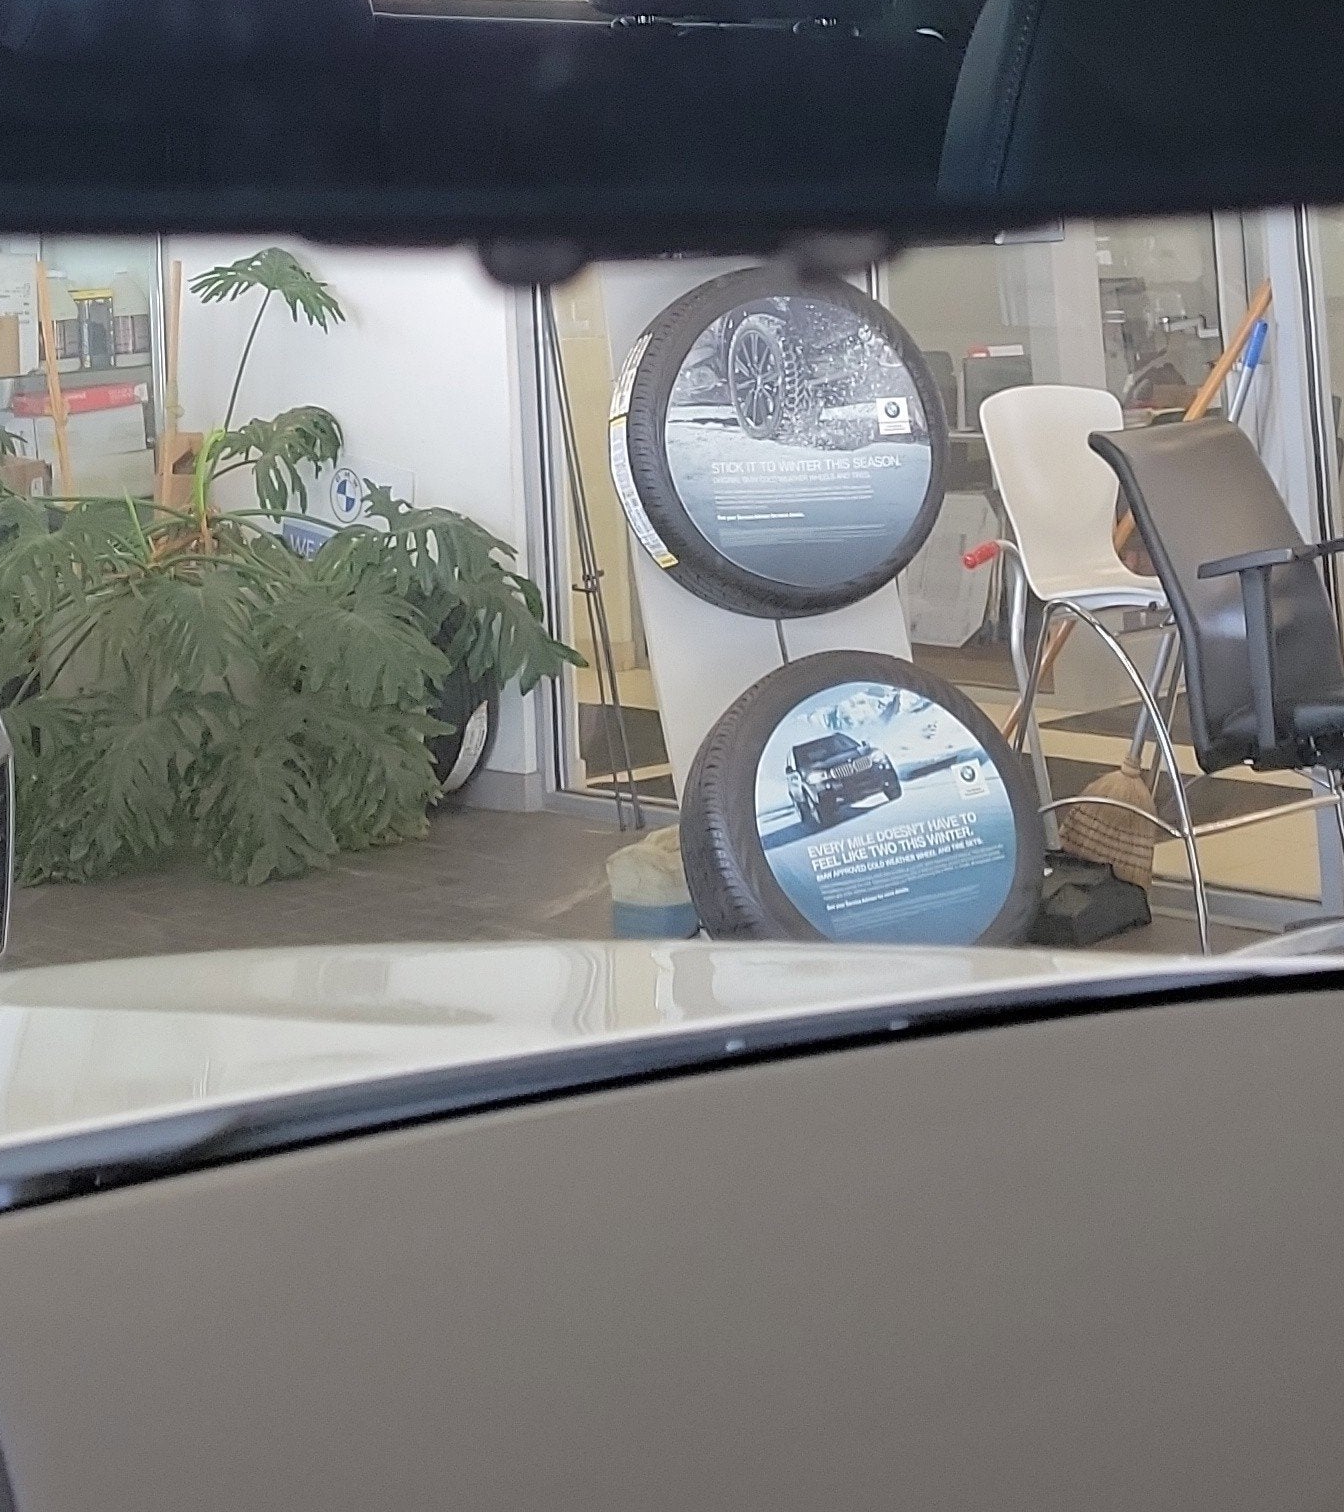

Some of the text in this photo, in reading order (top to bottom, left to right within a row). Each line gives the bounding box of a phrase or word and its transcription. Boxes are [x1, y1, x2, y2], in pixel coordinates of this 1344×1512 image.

[711, 455, 902, 474] STICK IT TO WINTER THIS SEASON.
[807, 811, 977, 859] EVERY MILE DOESN'T HAVE TO
[811, 827, 974, 872] FEEL LIKE TWO THIS WINTER.
